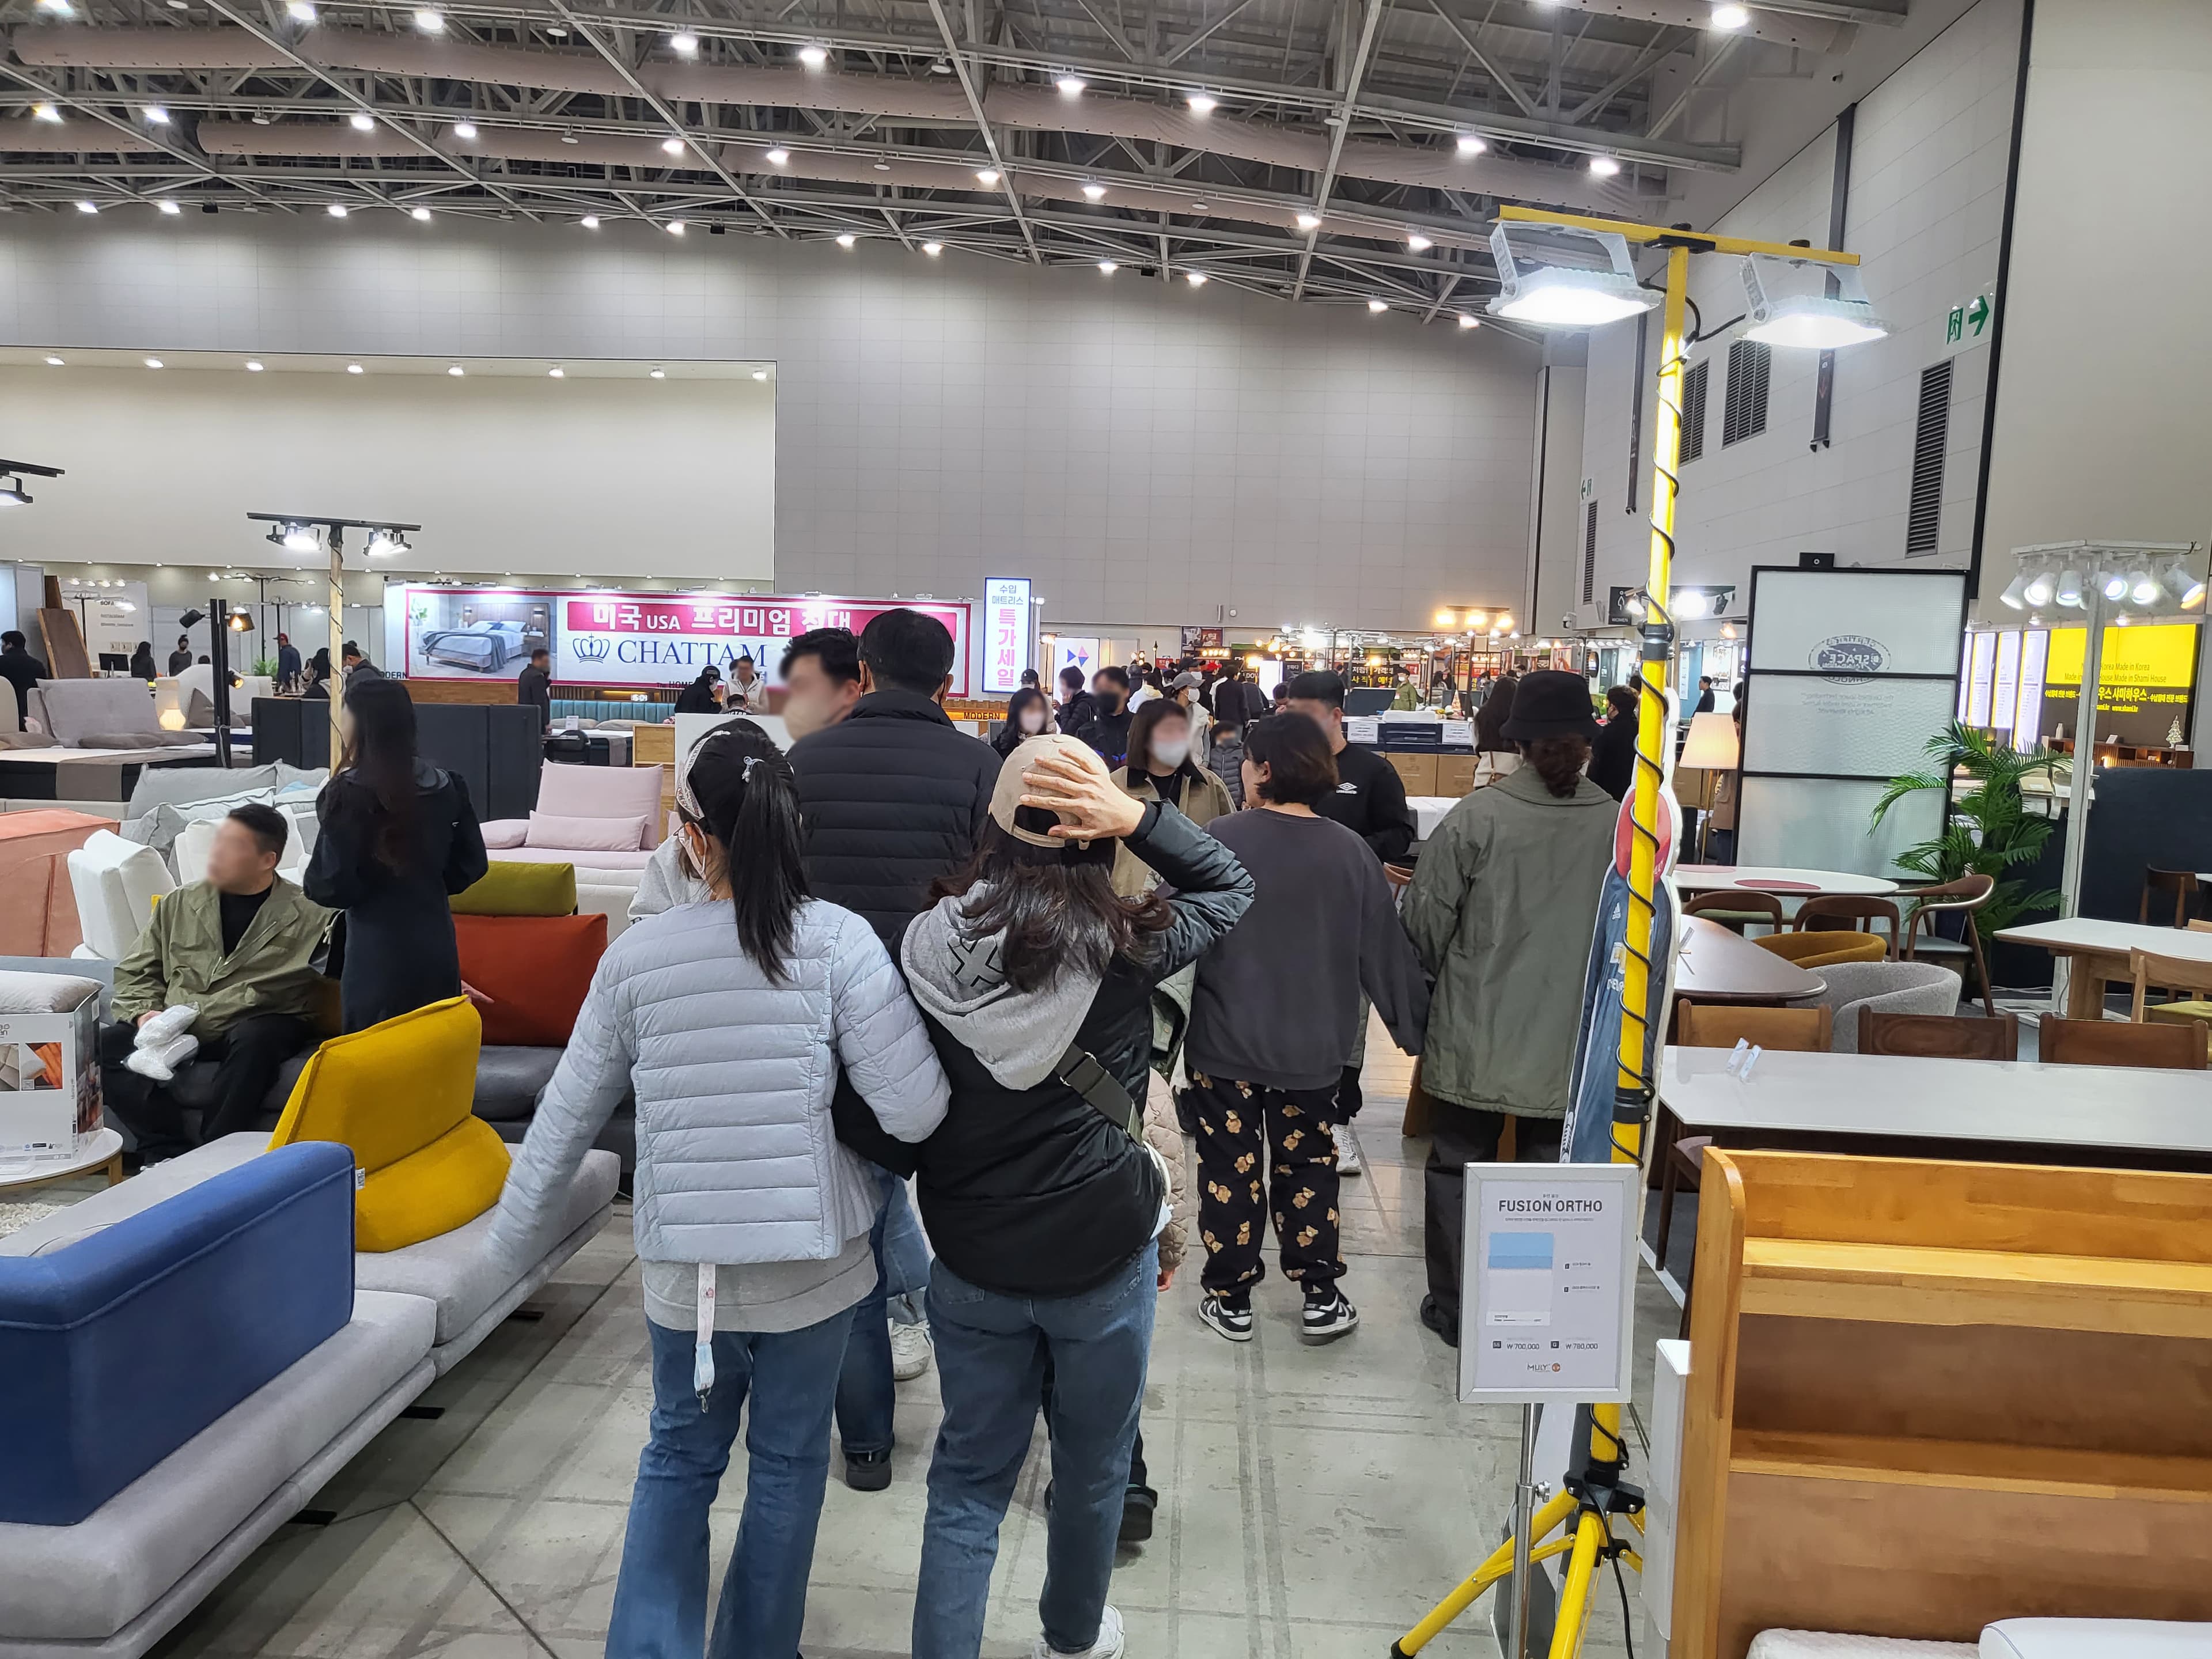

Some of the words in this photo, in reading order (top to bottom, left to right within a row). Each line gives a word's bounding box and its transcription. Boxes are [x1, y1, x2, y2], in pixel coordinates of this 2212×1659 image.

[999, 585, 1017, 594] 수입
[992, 595, 1024, 605] 매트리스
[593, 604, 642, 631] 미국
[647, 615, 681, 631] USA
[691, 607, 791, 635] 프리미엄
[618, 639, 768, 667] CHATTAM
[2116, 663, 2129, 671] Made
[2115, 674, 2127, 682] Made
[2150, 675, 2166, 683] House
[964, 711, 1001, 720] MODERN
[1498, 1200, 1552, 1212] FUSION
[1555, 1200, 1603, 1212] ORTHO
